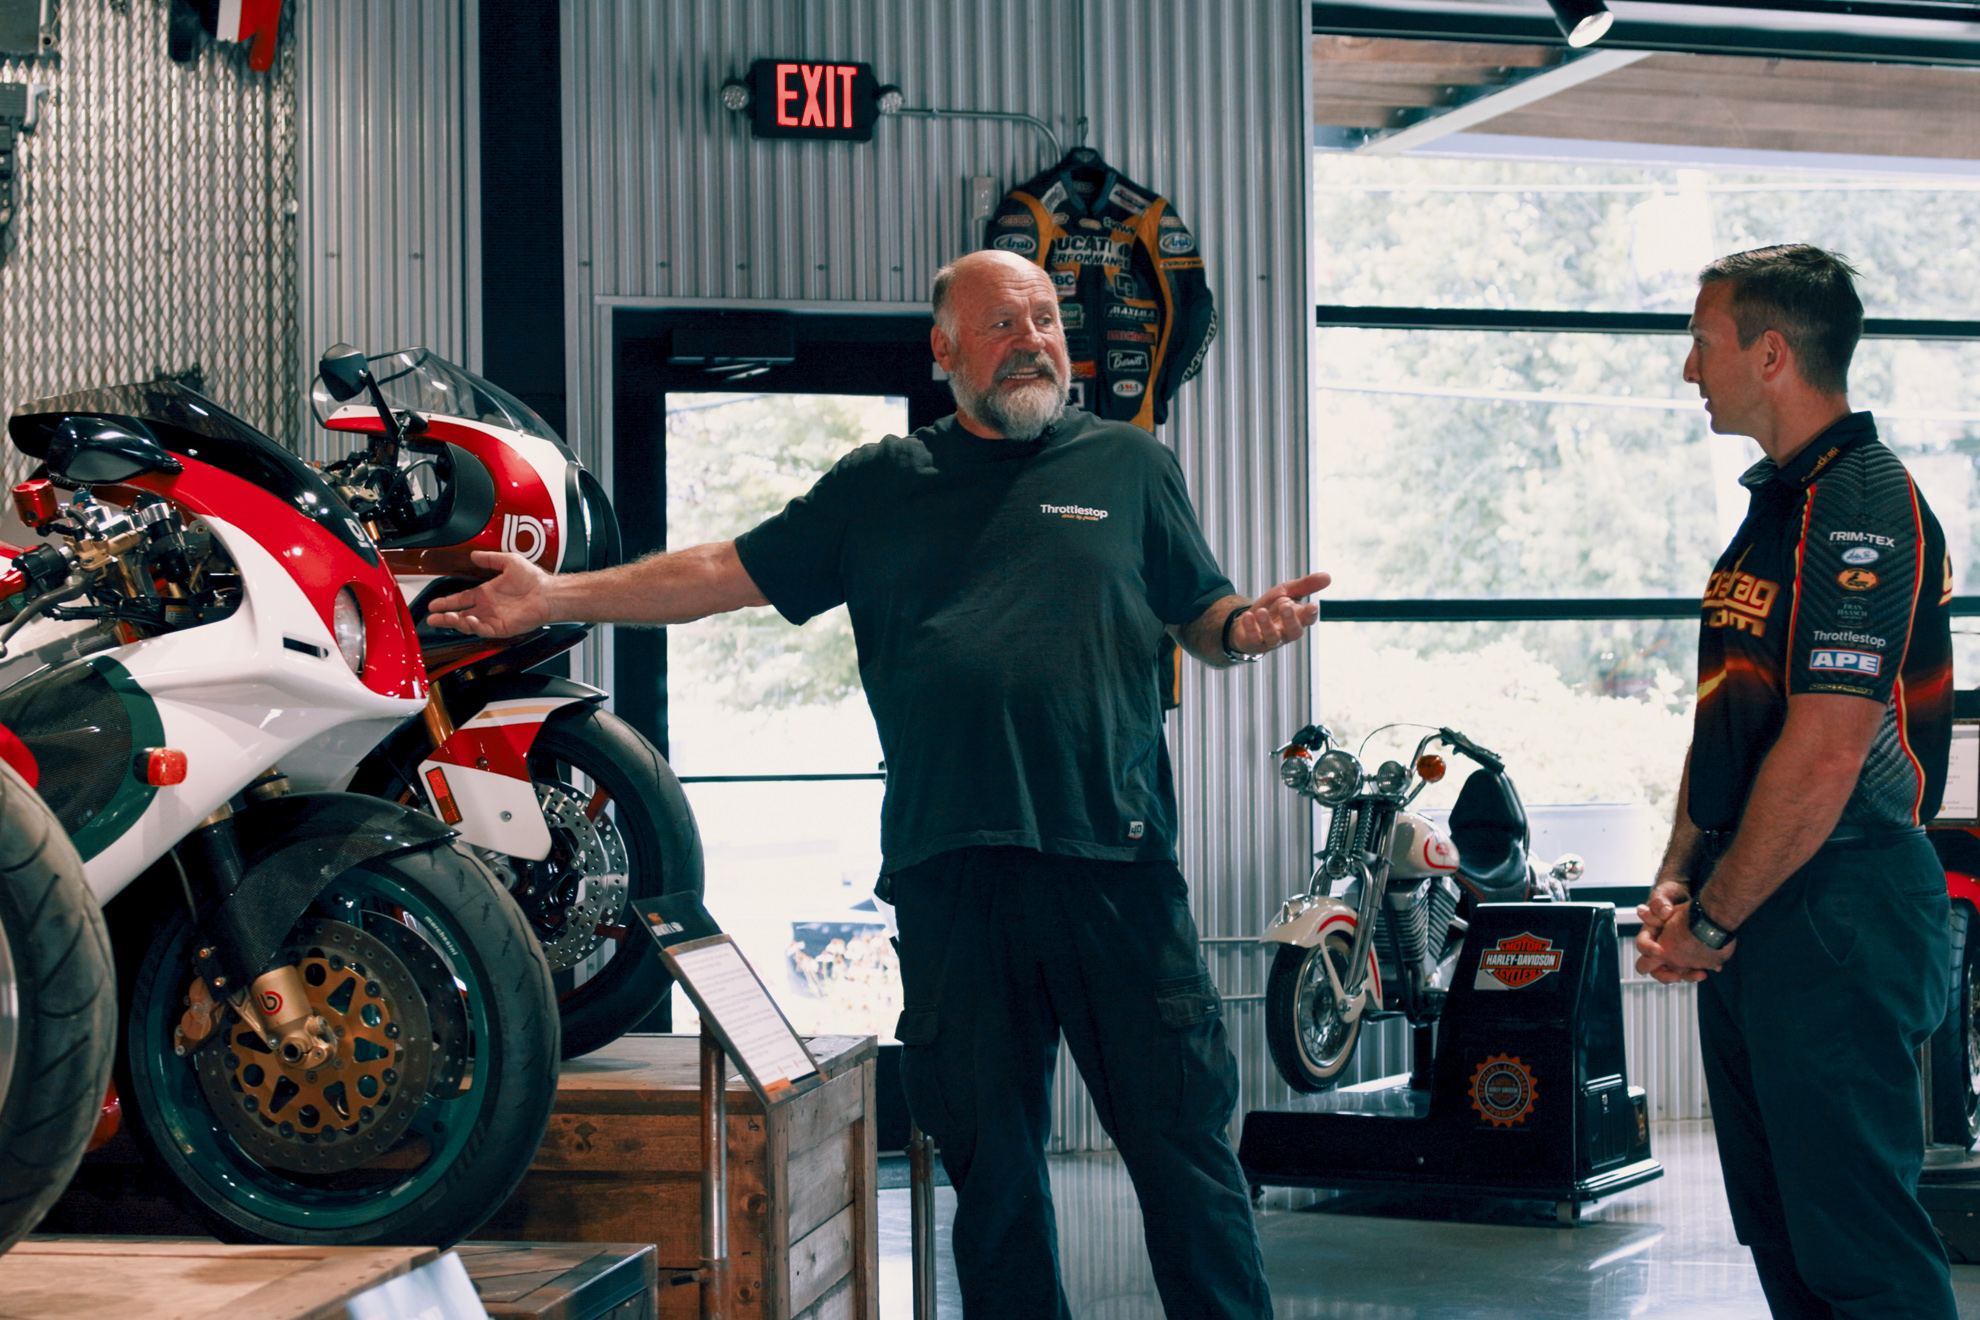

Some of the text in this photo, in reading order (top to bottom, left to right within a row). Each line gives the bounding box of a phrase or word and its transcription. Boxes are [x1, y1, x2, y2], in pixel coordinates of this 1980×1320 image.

[776, 63, 858, 128] EXIT
[1052, 236, 1112, 253] UCATI
[1052, 252, 1131, 270] ERFORMANCE
[1040, 504, 1108, 519] Throttlestop
[1829, 531, 1895, 548] TRIM-TEX
[1813, 630, 1886, 649] Throttlestop
[1813, 652, 1877, 672] APE
[1505, 939, 1543, 951] MOTOR
[1485, 954, 1557, 967] HARLEY-DAVIDSON
[1500, 969, 1536, 984] CYCLES
